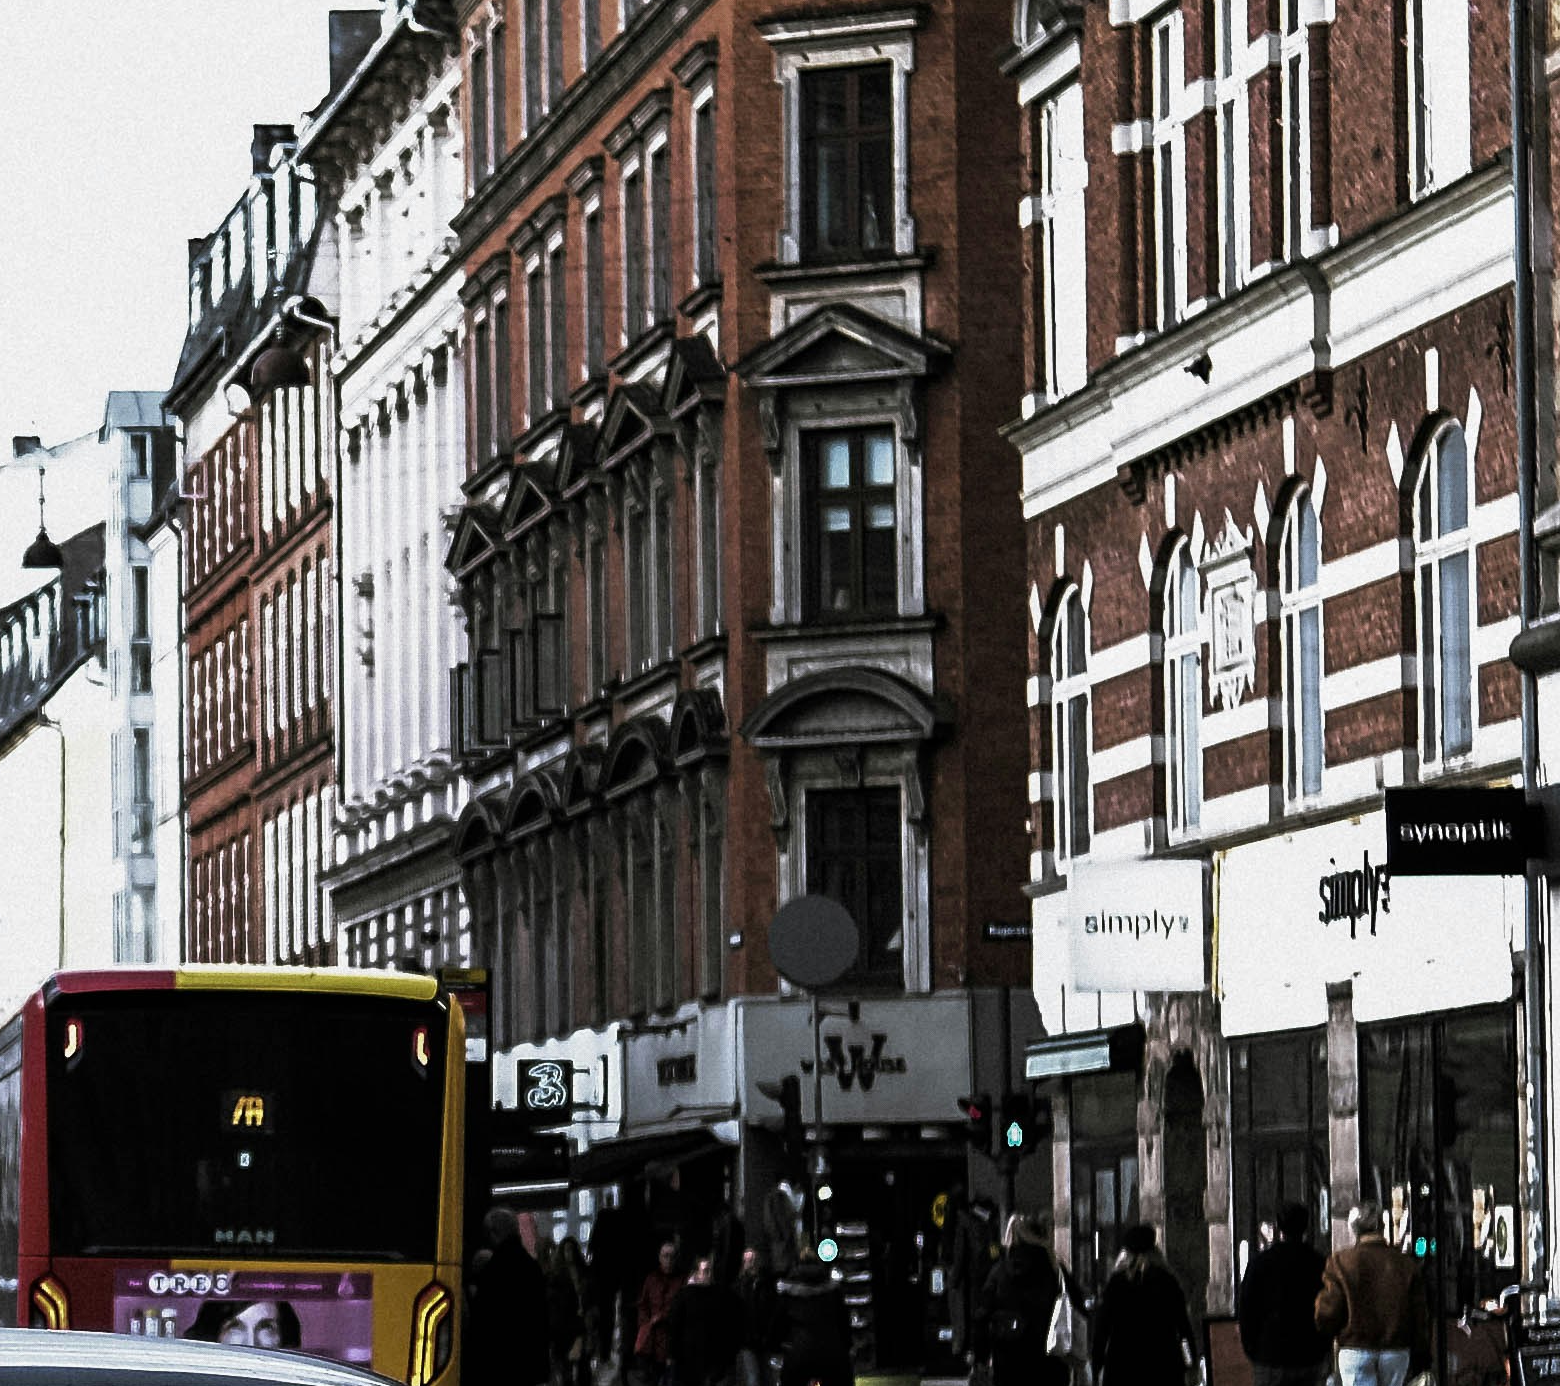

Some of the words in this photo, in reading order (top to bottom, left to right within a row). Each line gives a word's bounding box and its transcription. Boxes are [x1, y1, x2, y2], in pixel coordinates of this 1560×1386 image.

[1400, 819, 1512, 844] synoptik
[1318, 849, 1378, 940] simply
[1085, 909, 1175, 940] simply
[215, 1229, 275, 1243] MAN
